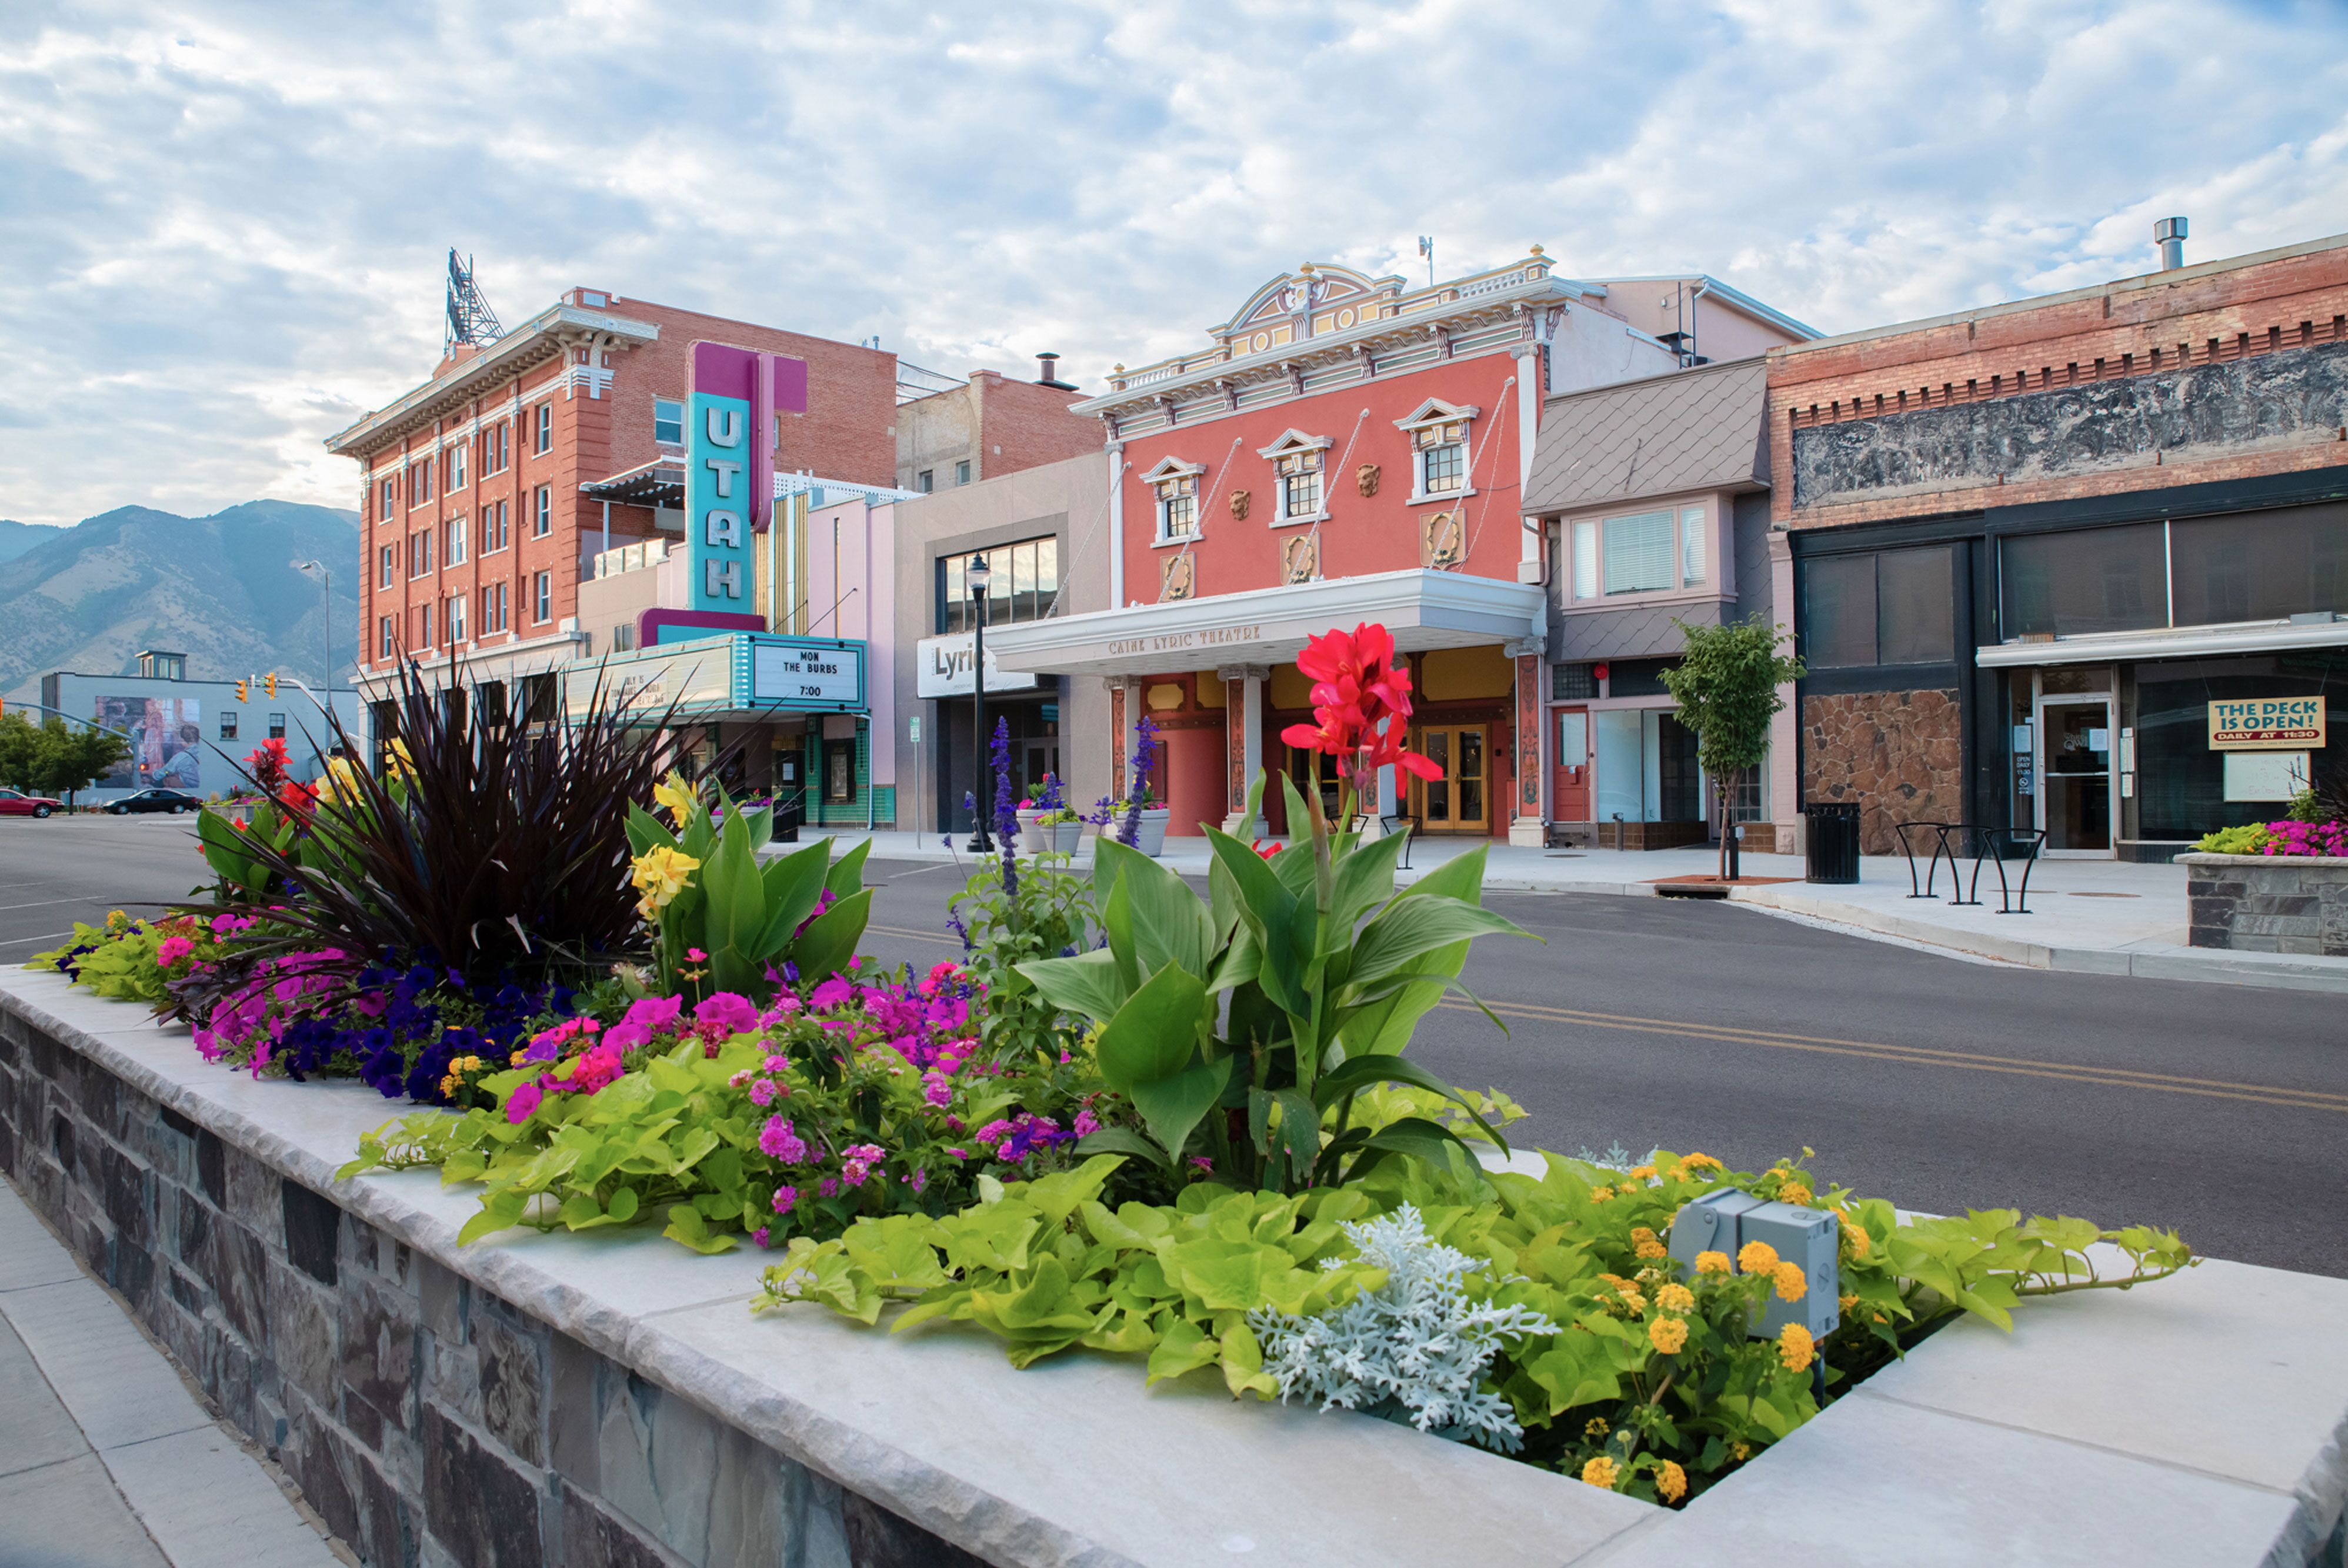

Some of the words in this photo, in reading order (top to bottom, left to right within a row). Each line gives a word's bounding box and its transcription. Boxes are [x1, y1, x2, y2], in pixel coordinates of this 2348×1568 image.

[706, 408, 742, 598] UTAH
[1108, 639, 1144, 654] CAINE
[1154, 633, 1192, 650] LYRIC
[1200, 626, 1260, 644] THEATRE
[801, 652, 819, 662] MON
[783, 662, 800, 672] THE
[807, 663, 838, 674] BURBS
[800, 686, 821, 696] 7:00
[2214, 703, 2256, 716] THE
[2263, 701, 2317, 715] DECK
[2221, 717, 2238, 730] IS
[2243, 715, 2313, 729] OPEN!
